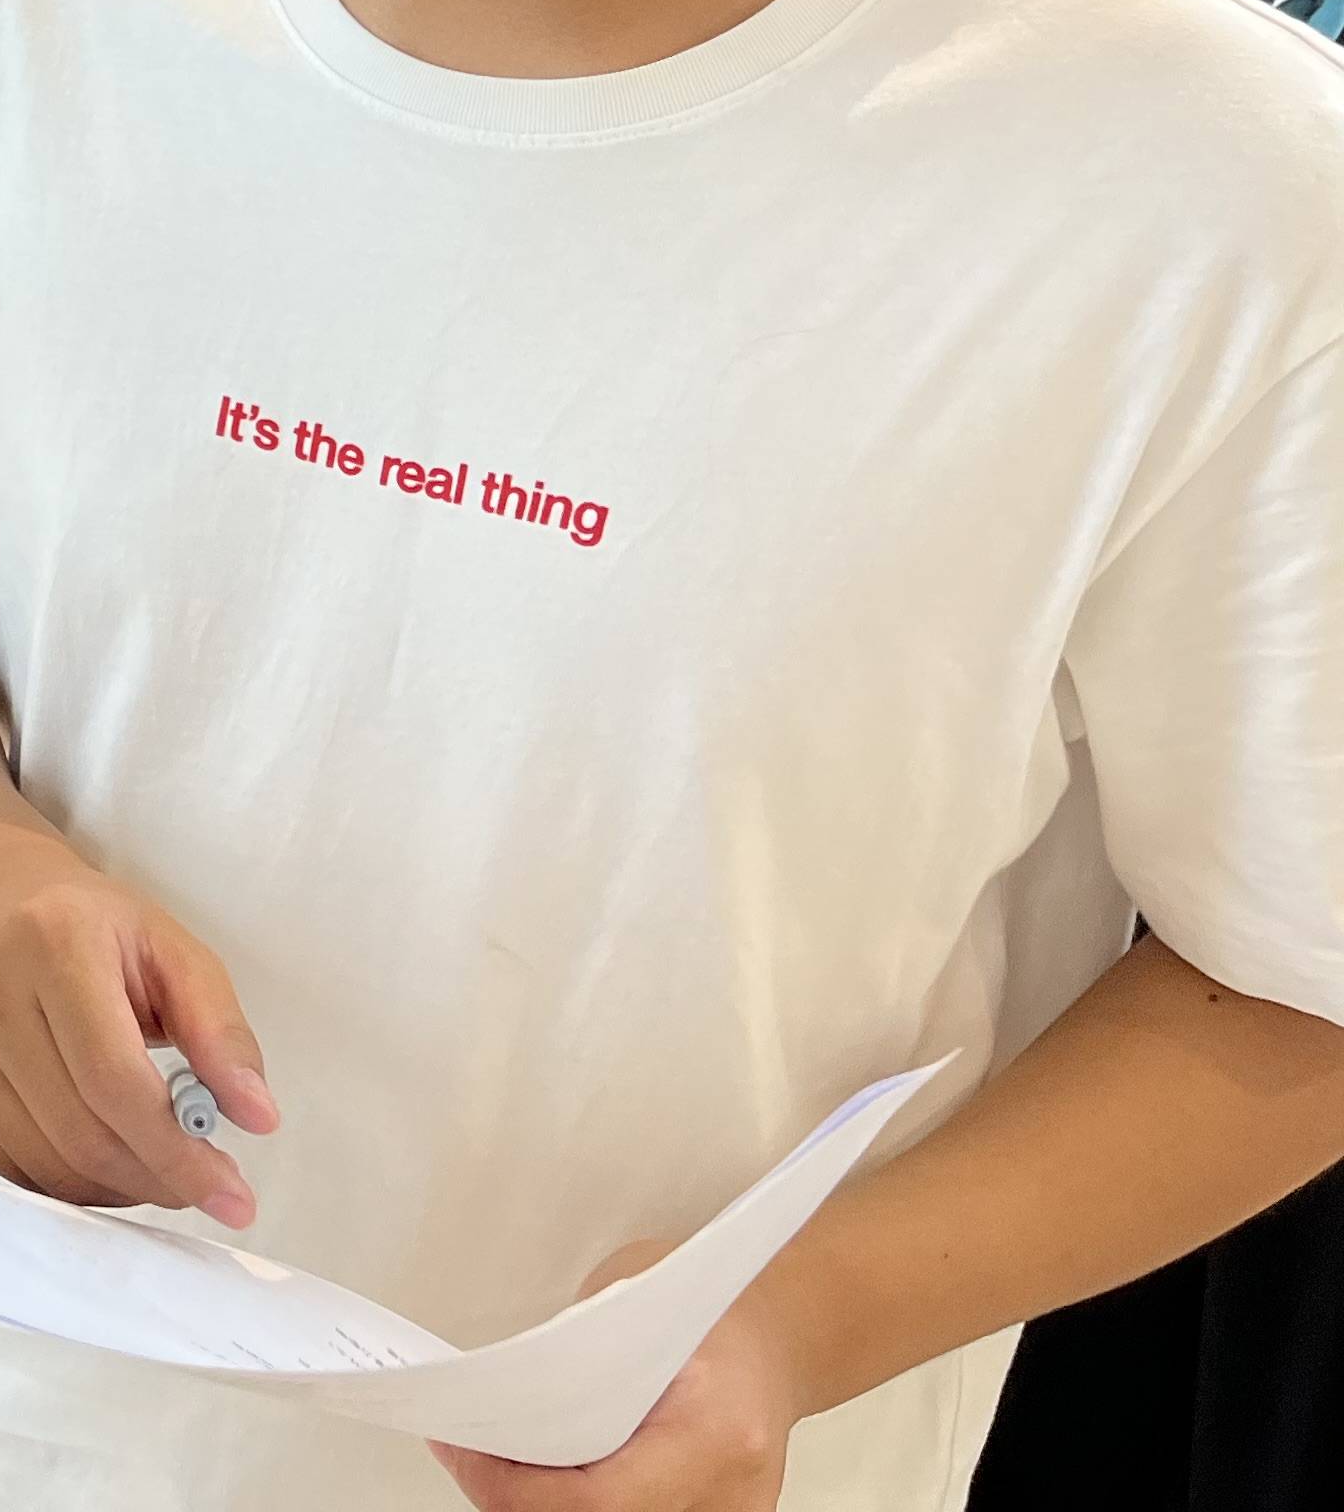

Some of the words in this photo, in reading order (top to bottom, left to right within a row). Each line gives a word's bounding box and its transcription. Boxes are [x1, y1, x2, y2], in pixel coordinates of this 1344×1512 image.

[214, 395, 280, 451] It's
[293, 420, 365, 476] the
[378, 454, 468, 505] real
[480, 472, 610, 548] thing
